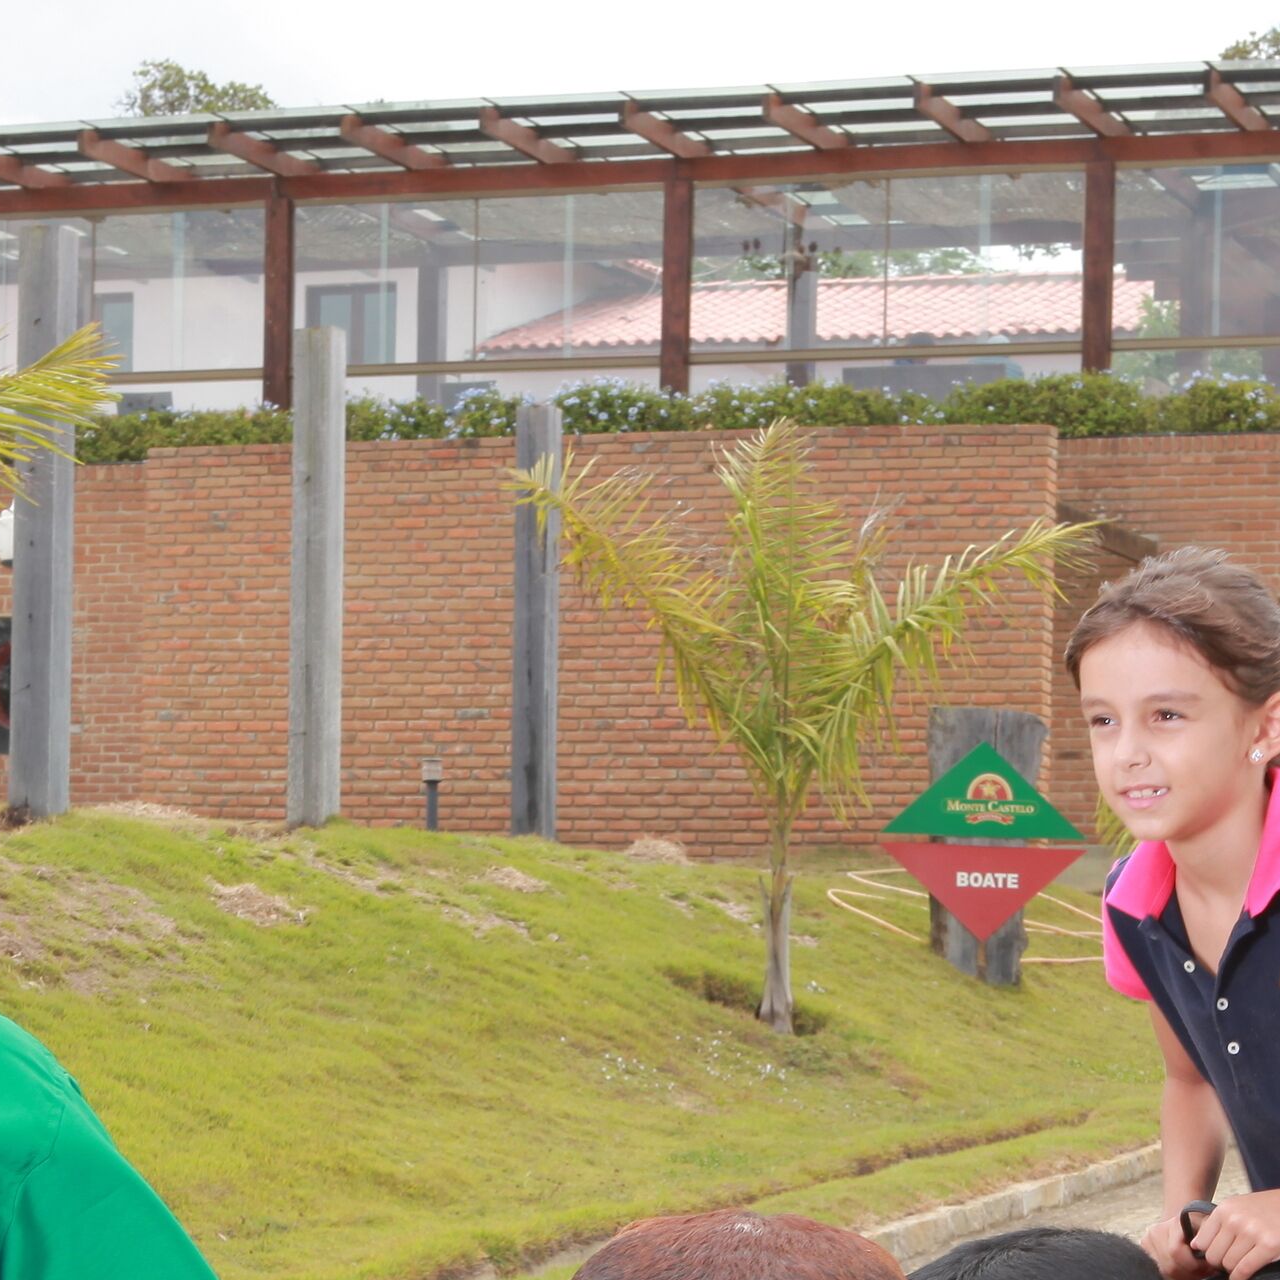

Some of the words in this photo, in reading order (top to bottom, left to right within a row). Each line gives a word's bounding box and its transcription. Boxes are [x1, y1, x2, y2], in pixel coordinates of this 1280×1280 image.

[946, 800, 985, 812] MONTE
[987, 801, 1035, 814] CASTELO
[956, 871, 1019, 888] BOATE
